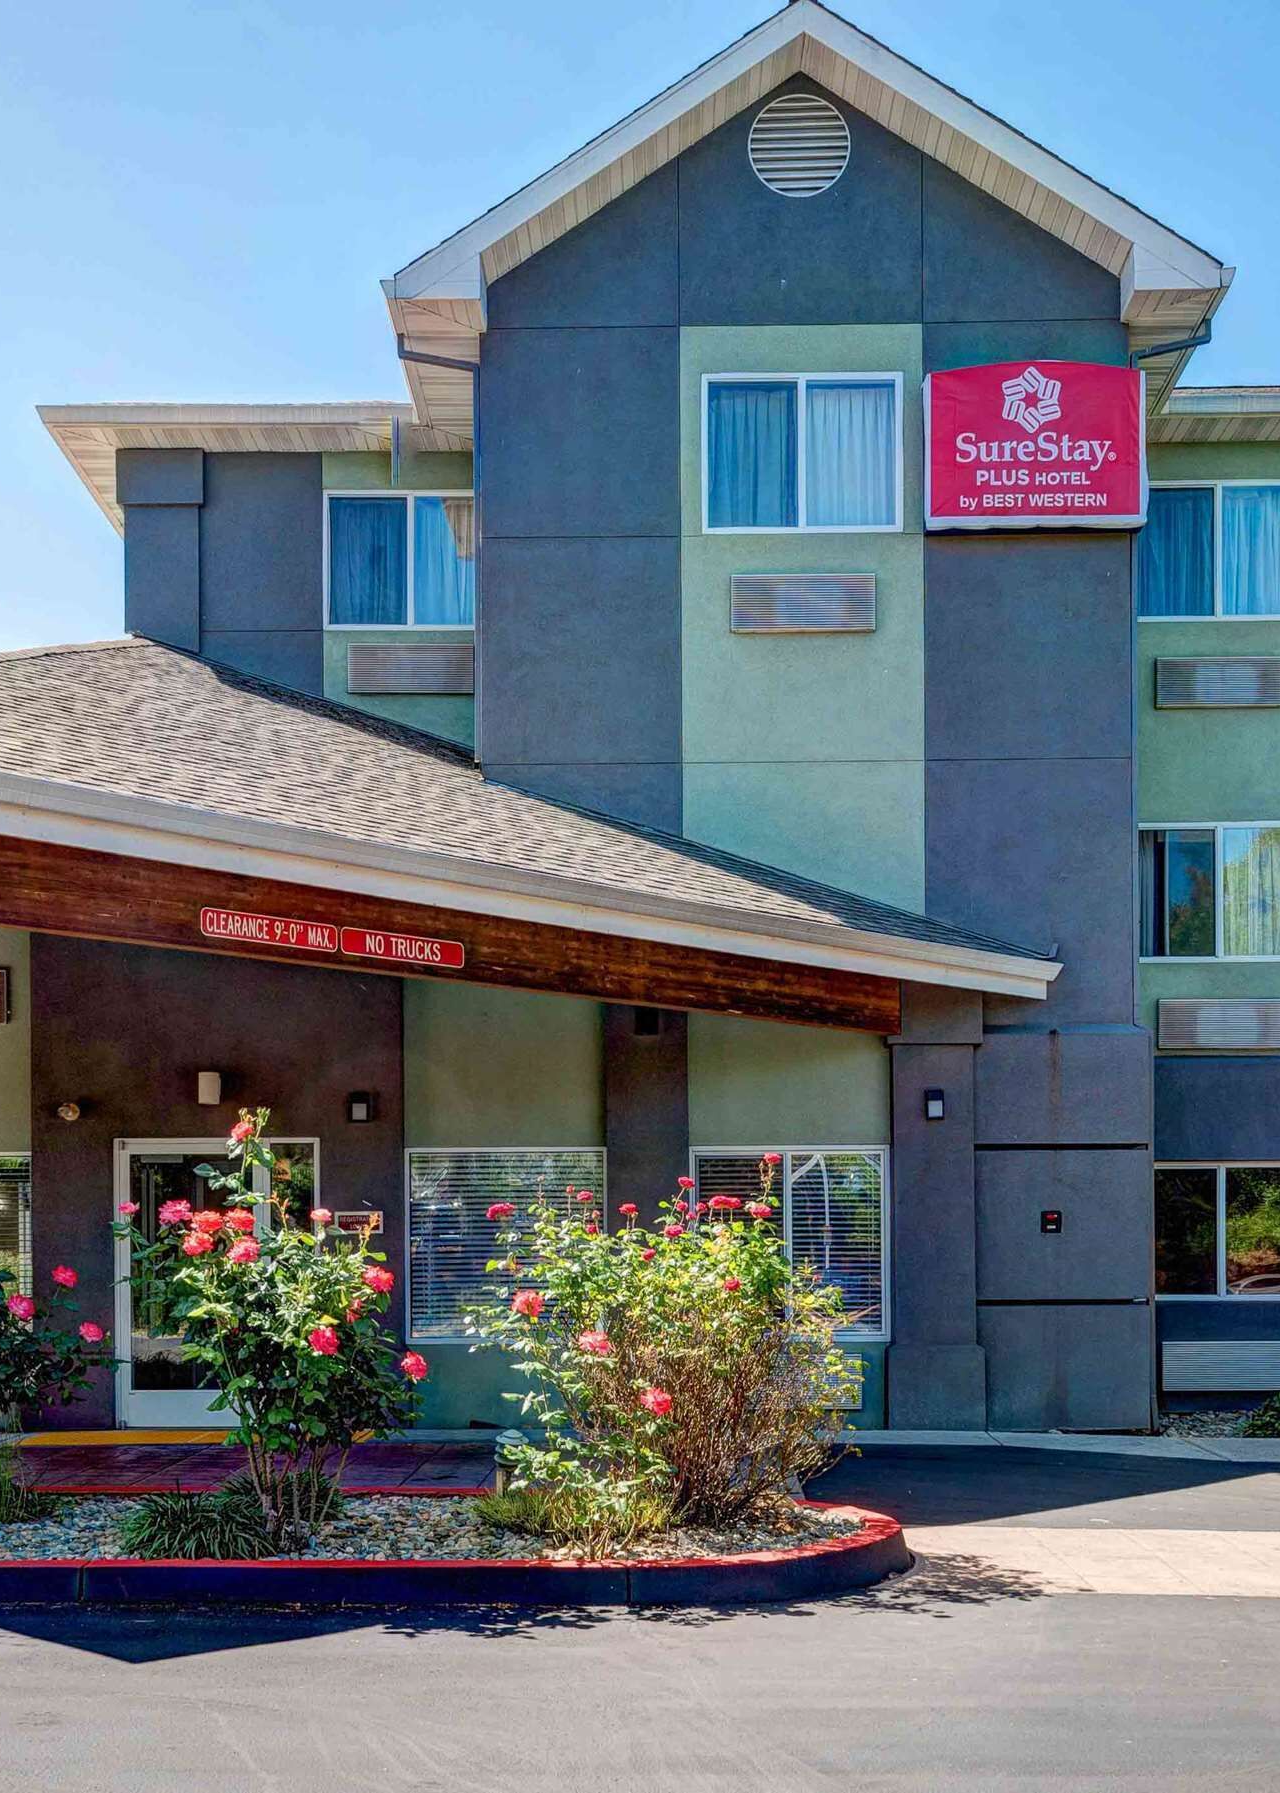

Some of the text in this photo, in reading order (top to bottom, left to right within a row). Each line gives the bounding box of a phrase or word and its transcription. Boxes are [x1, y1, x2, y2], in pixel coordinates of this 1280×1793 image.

[976, 469, 1091, 486] PLUS HOTEL
[959, 493, 1107, 511] by BEST WESTERN
[206, 911, 270, 940] CLEARANCE
[307, 929, 334, 949] MAX.
[365, 934, 442, 962] NO TRUCKS
